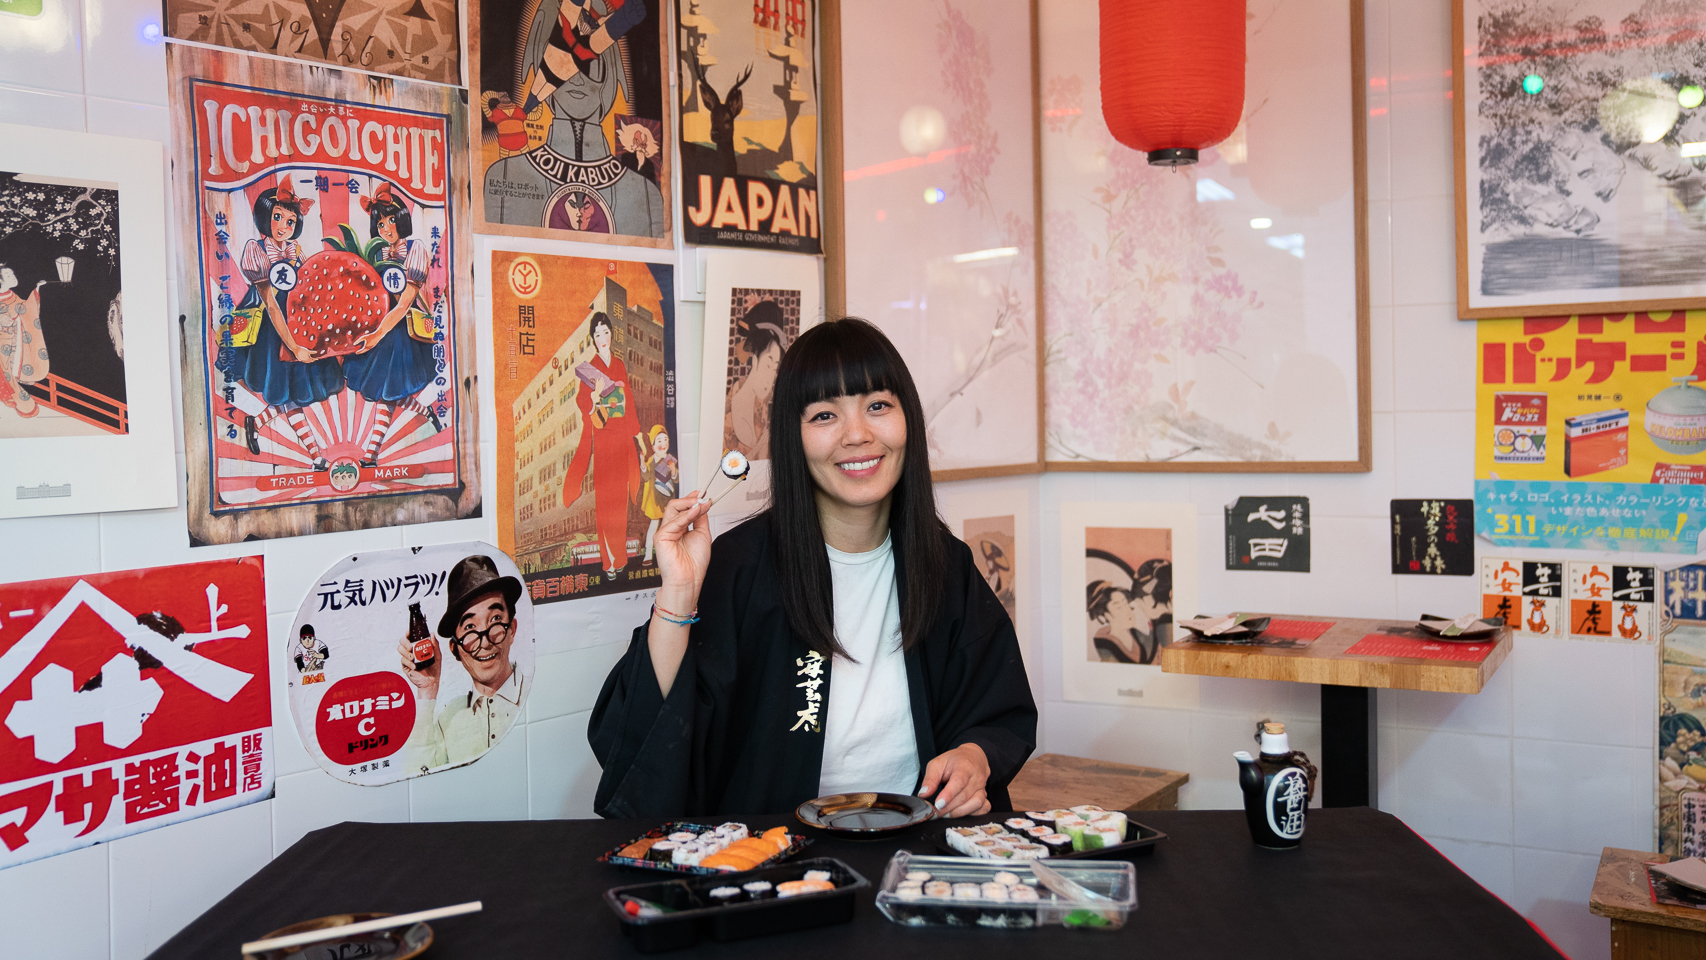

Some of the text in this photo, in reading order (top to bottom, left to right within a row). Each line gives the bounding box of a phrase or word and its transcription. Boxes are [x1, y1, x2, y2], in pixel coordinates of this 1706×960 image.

[532, 147, 622, 186] KOJI KABUTO
[300, 175, 360, 194] 一期一会
[688, 174, 818, 238] JAPAN
[215, 210, 231, 260] 出会い
[717, 231, 743, 241] JAPANESE
[744, 233, 777, 243] GOVERNMENT
[274, 266, 292, 285] 友
[387, 272, 402, 288] 情
[518, 305, 535, 356] 開店
[1650, 422, 1706, 439] MELONBAL
[271, 467, 408, 487] TRADE MARK
[1551, 506, 1646, 518] いまだ色あせない
[1247, 504, 1288, 560] 七田
[1494, 514, 1536, 535] 311
[317, 570, 447, 612] 元気ハツラツ!
[185, 582, 251, 644] 上
[326, 692, 405, 722] オロナミン
[357, 717, 376, 736] C
[348, 734, 389, 754] ドリンク
[348, 759, 391, 776] 大塚製薬
